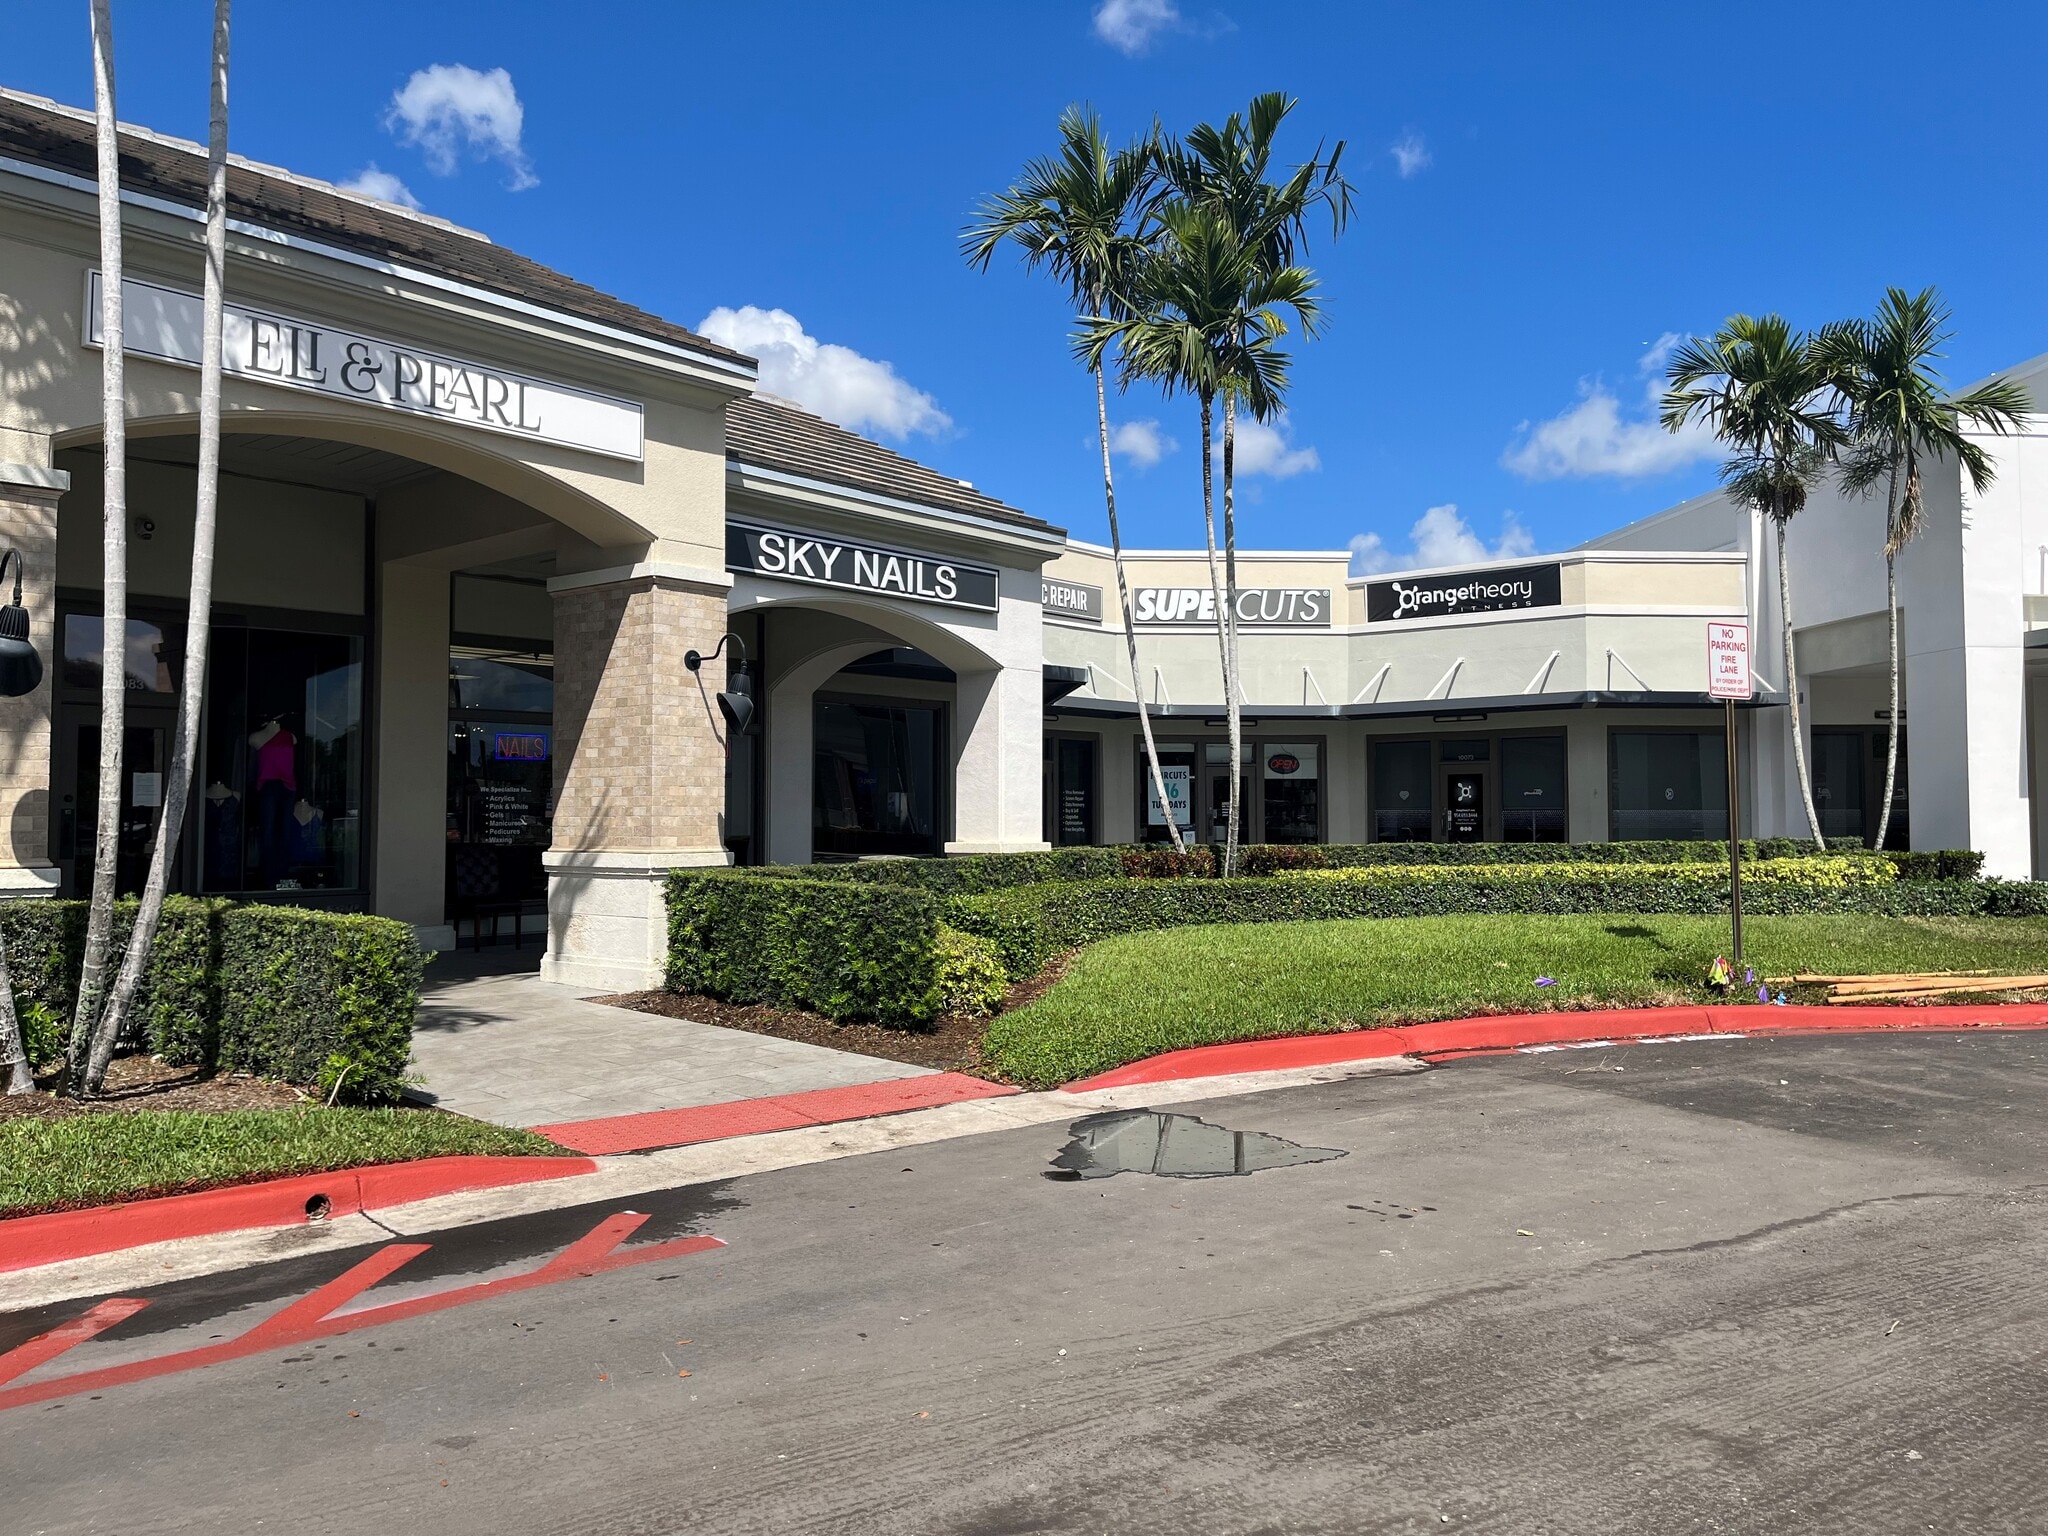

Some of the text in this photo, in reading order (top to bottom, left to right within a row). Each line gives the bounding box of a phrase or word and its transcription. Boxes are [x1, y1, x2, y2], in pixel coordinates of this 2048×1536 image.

[340, 342, 383, 393] &
[389, 350, 541, 433] PEARL
[758, 533, 957, 600] SKY NAILS
[1050, 585, 1088, 611] REPAIR
[1392, 580, 1532, 619] Orangetheory
[1448, 600, 1532, 613] FITNESS
[1721, 628, 1734, 639] NO
[1711, 640, 1746, 652] PARKING
[1721, 655, 1736, 664] FIRE
[1720, 665, 1738, 674] LANE
[497, 736, 544, 758] NAILS
[1270, 759, 1297, 770] OPEN
[1150, 771, 1187, 780] IRCUTS
[489, 795, 515, 803] Acrylics
[1151, 800, 1187, 809] TUDAYS
